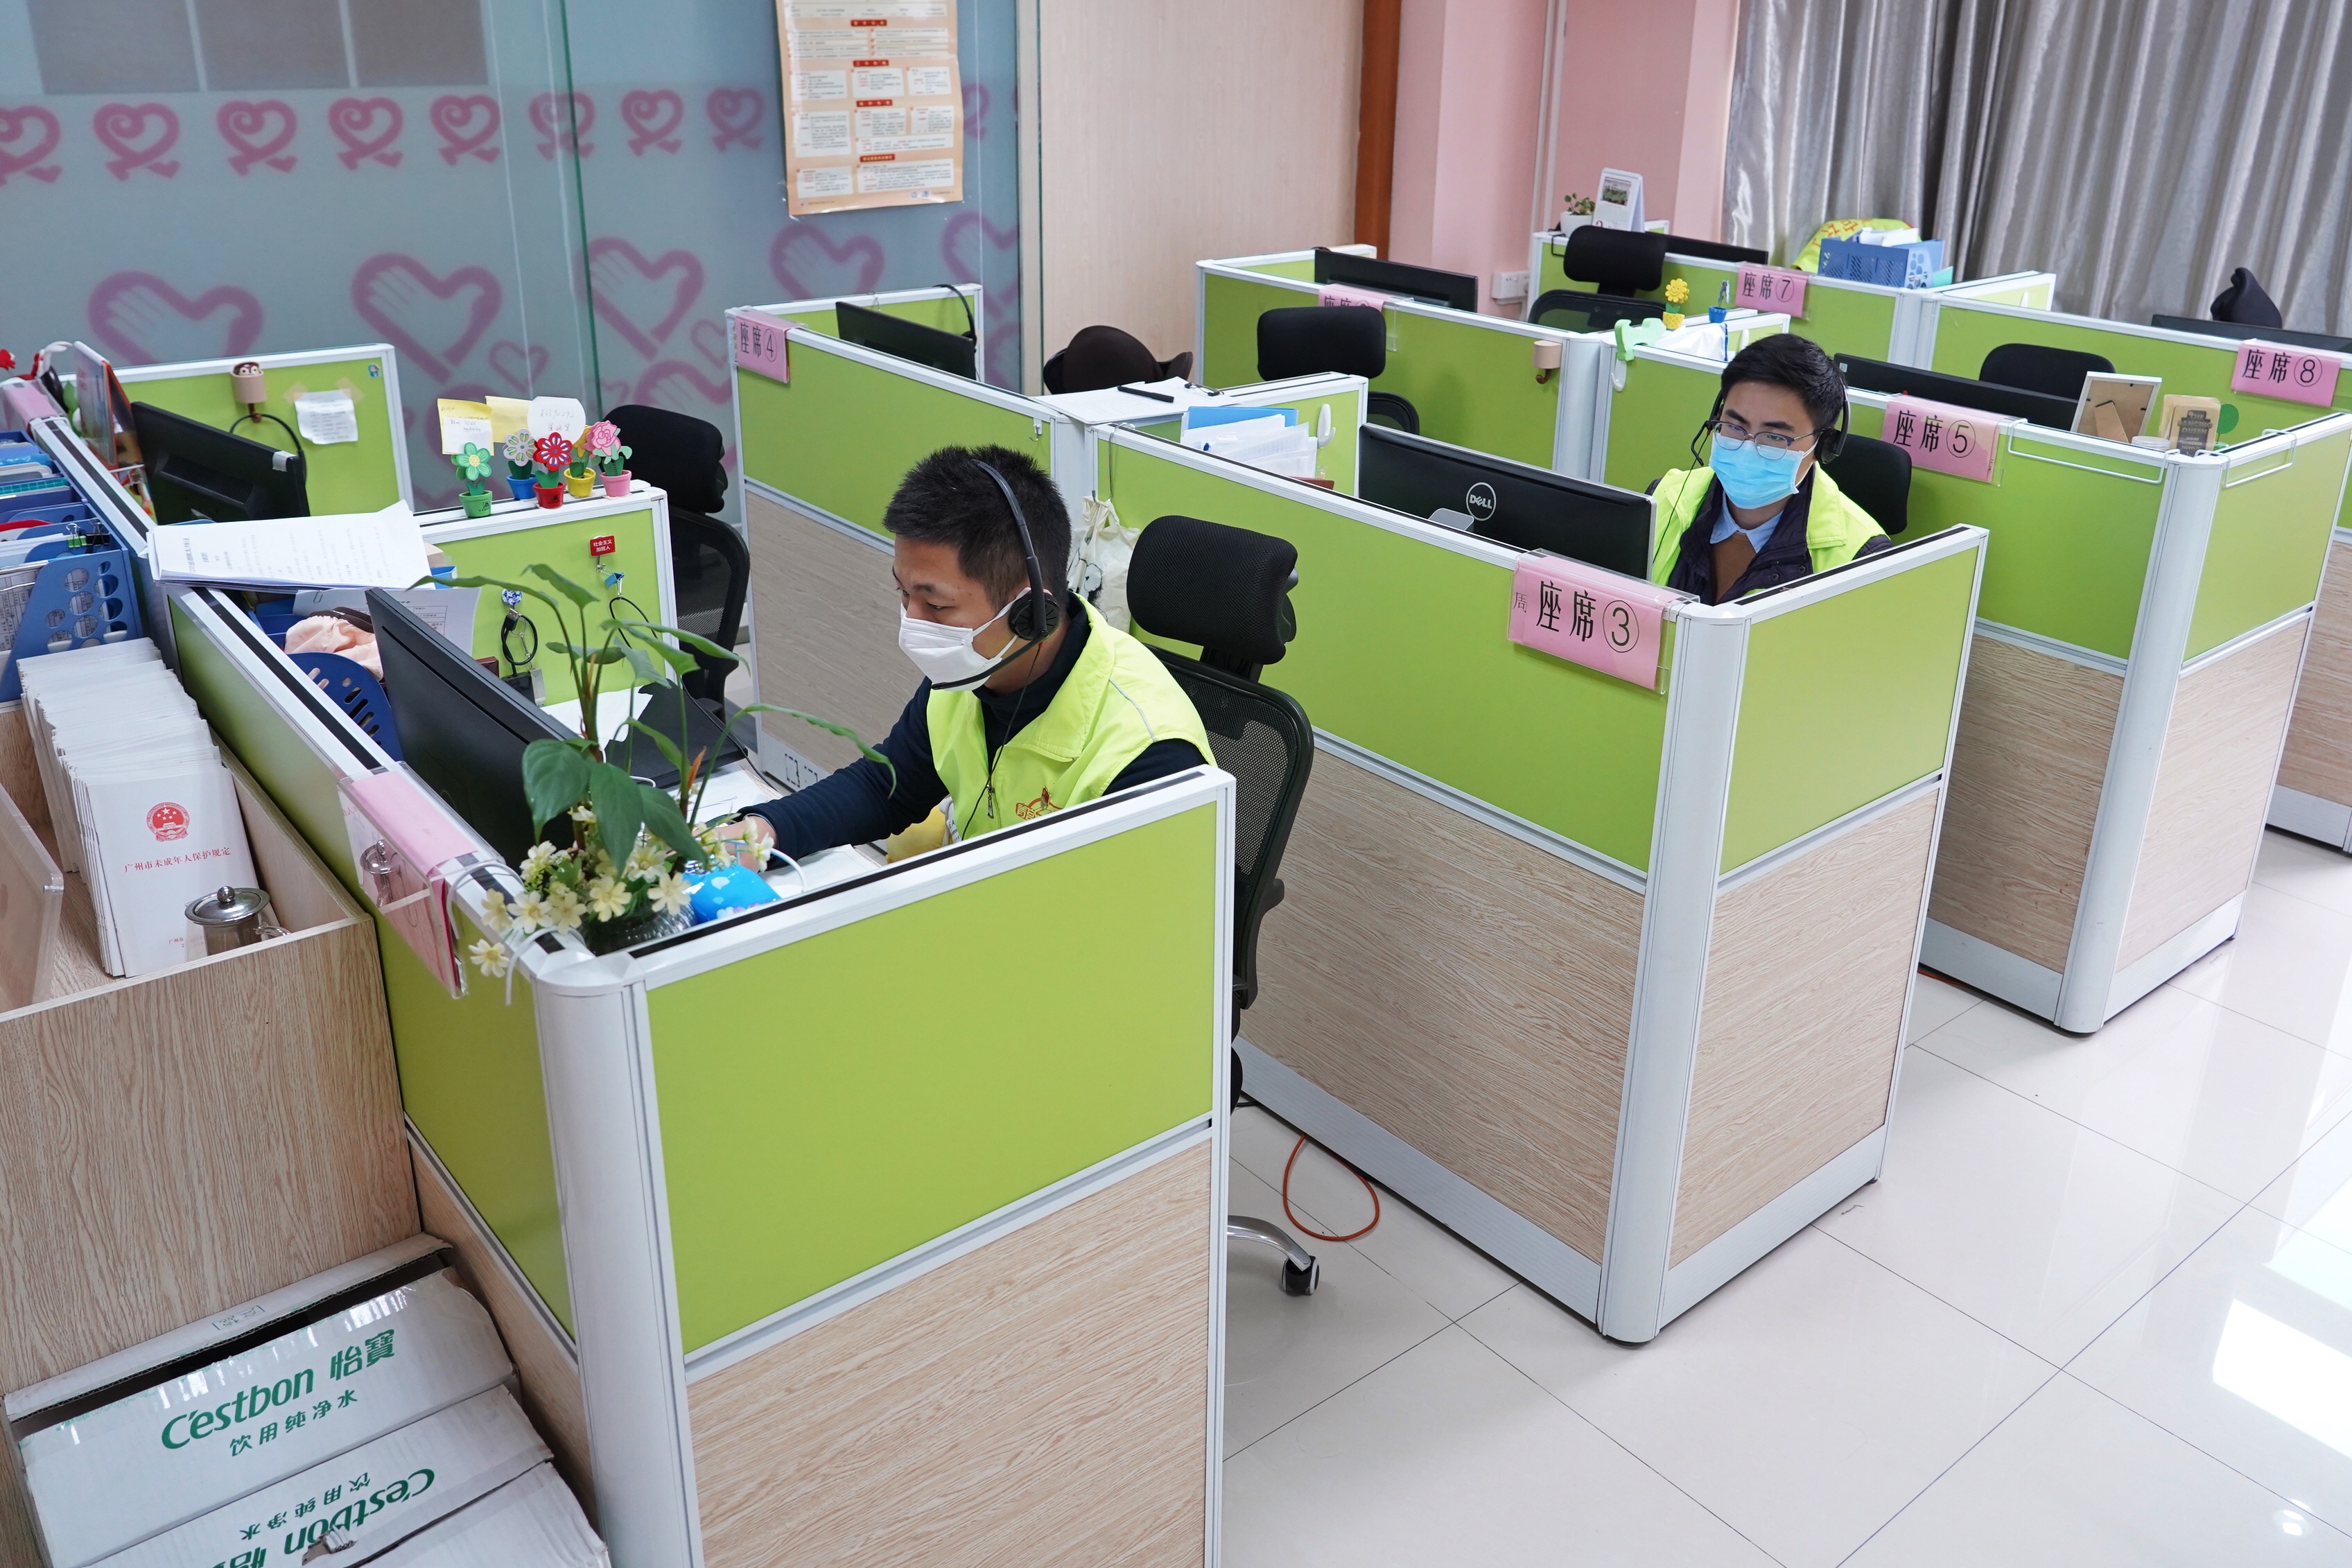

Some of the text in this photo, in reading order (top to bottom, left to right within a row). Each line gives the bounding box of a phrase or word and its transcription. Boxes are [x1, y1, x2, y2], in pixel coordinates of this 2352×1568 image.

[1469, 494, 1492, 509] DELL
[124, 847, 230, 873] 广州市未成年人保护规定
[230, 1389, 358, 1456] 饮用纯净水
[240, 1472, 370, 1540] 饮用纯净水
